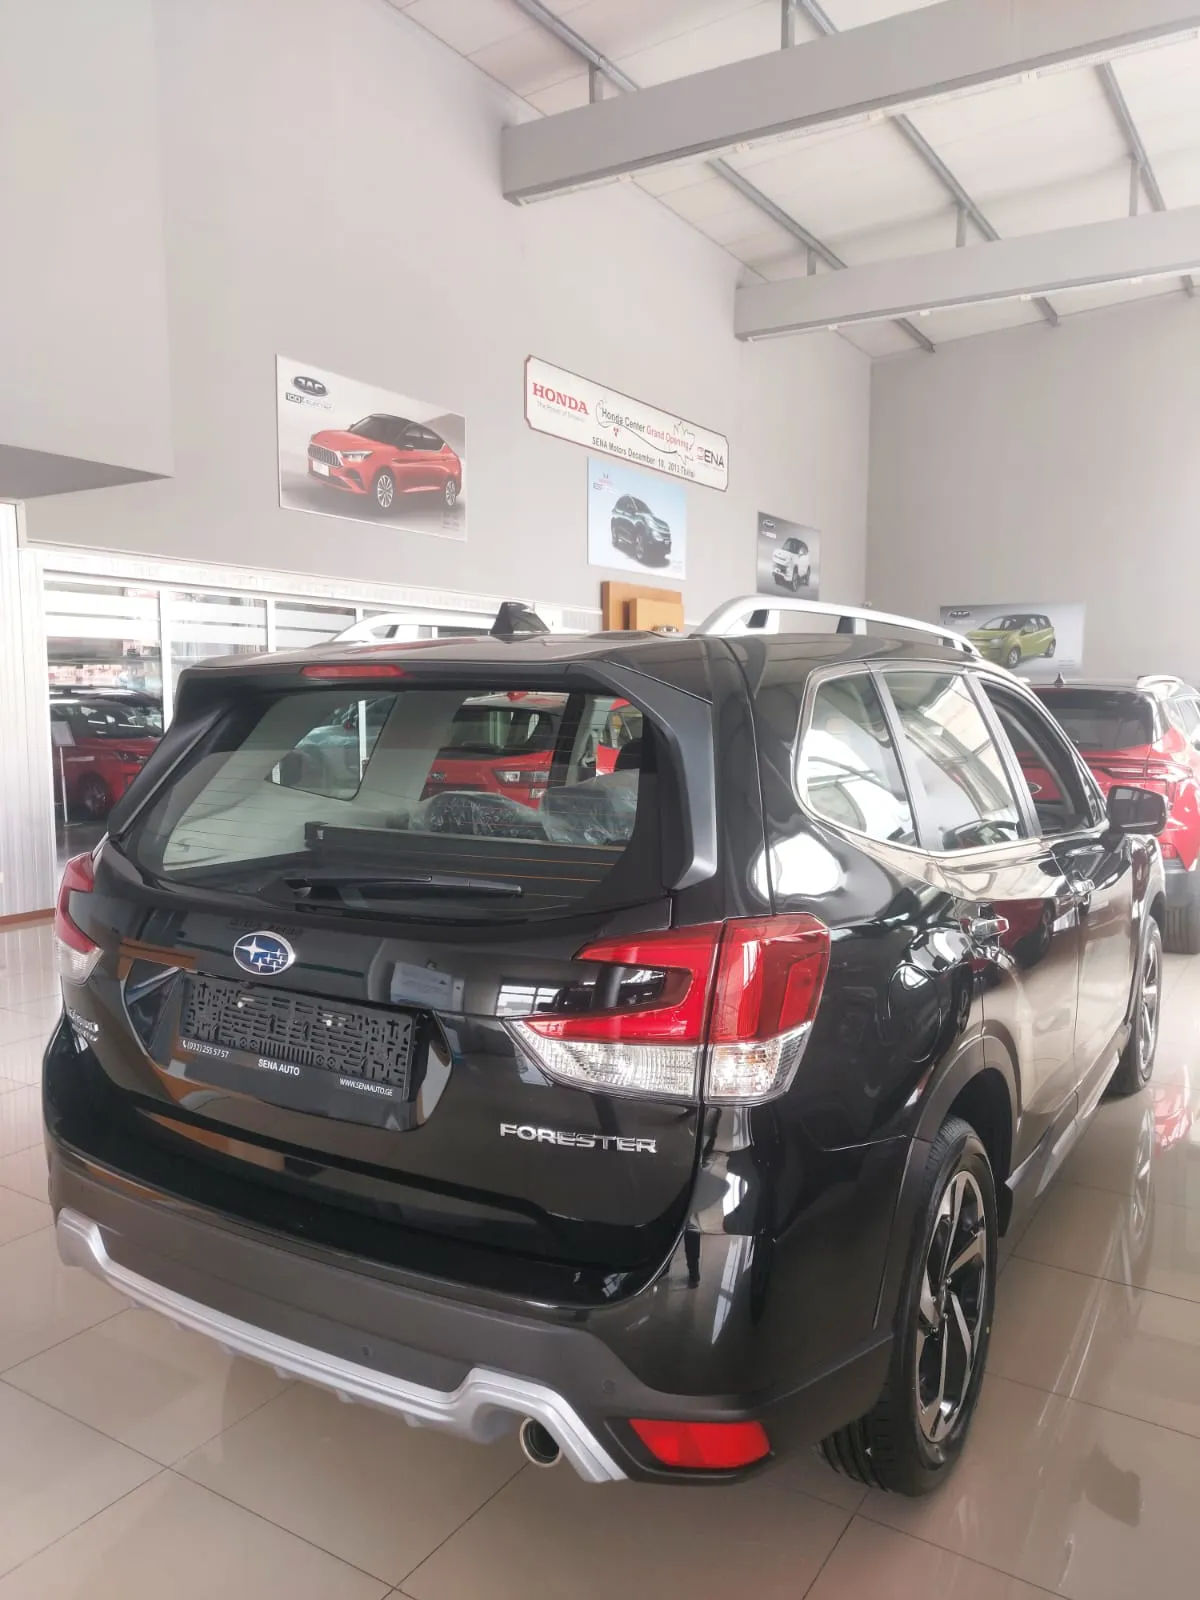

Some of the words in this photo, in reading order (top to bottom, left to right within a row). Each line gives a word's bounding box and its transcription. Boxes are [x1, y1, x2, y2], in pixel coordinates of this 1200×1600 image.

[532, 382, 590, 415] HONDA
[601, 407, 624, 426] Honda
[625, 416, 646, 433] Center
[646, 425, 665, 440] Grand
[665, 432, 690, 451] Opening
[592, 436, 608, 449] SENA
[608, 442, 627, 456] Motors
[628, 447, 656, 465] December
[257, 1058, 278, 1072] SENA
[278, 1063, 300, 1076] AUTO
[339, 1077, 393, 1097] WWW.SENAAUTO.GE
[500, 1122, 657, 1154] FORESTER
